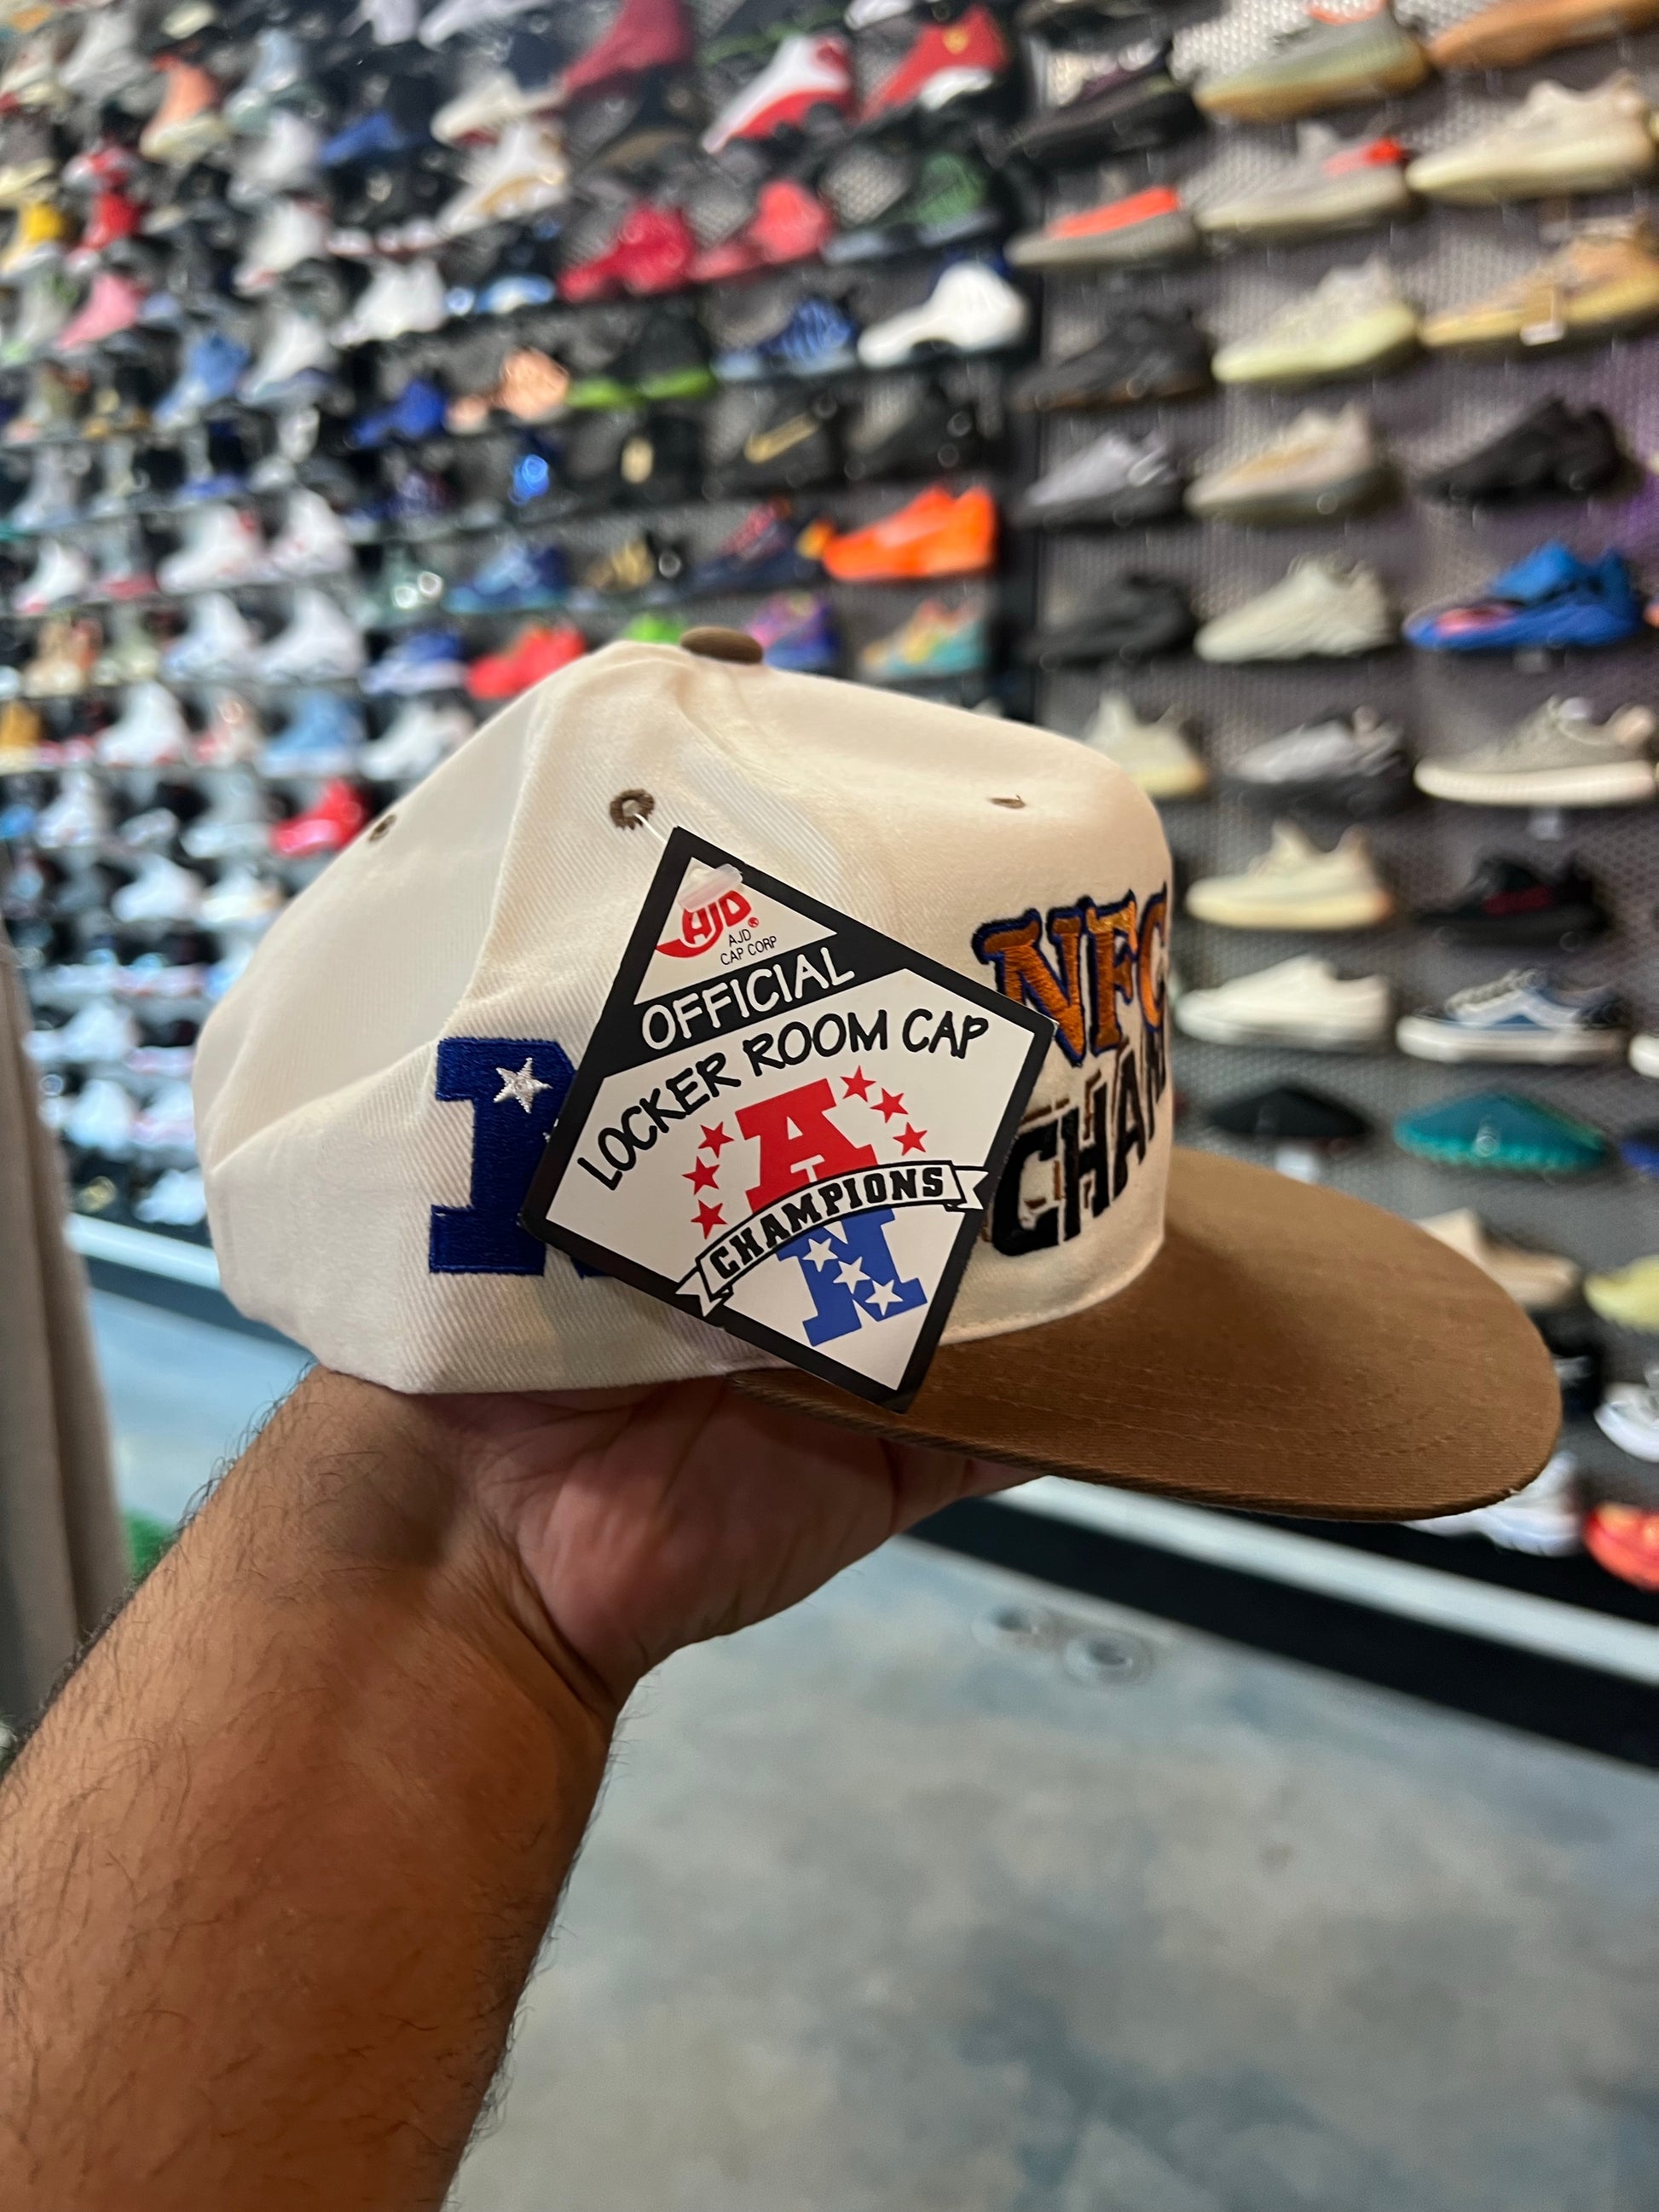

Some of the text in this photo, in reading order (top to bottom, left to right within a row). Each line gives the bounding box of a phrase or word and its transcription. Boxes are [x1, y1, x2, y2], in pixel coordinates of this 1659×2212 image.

[720, 935, 777, 965] CAP CORP
[728, 928, 752, 947] AJD
[643, 946, 855, 1050] OFFICIAL
[577, 1008, 989, 1190] LOCKER ROOM CAP
[709, 1166, 944, 1280] CHAMPIONS
